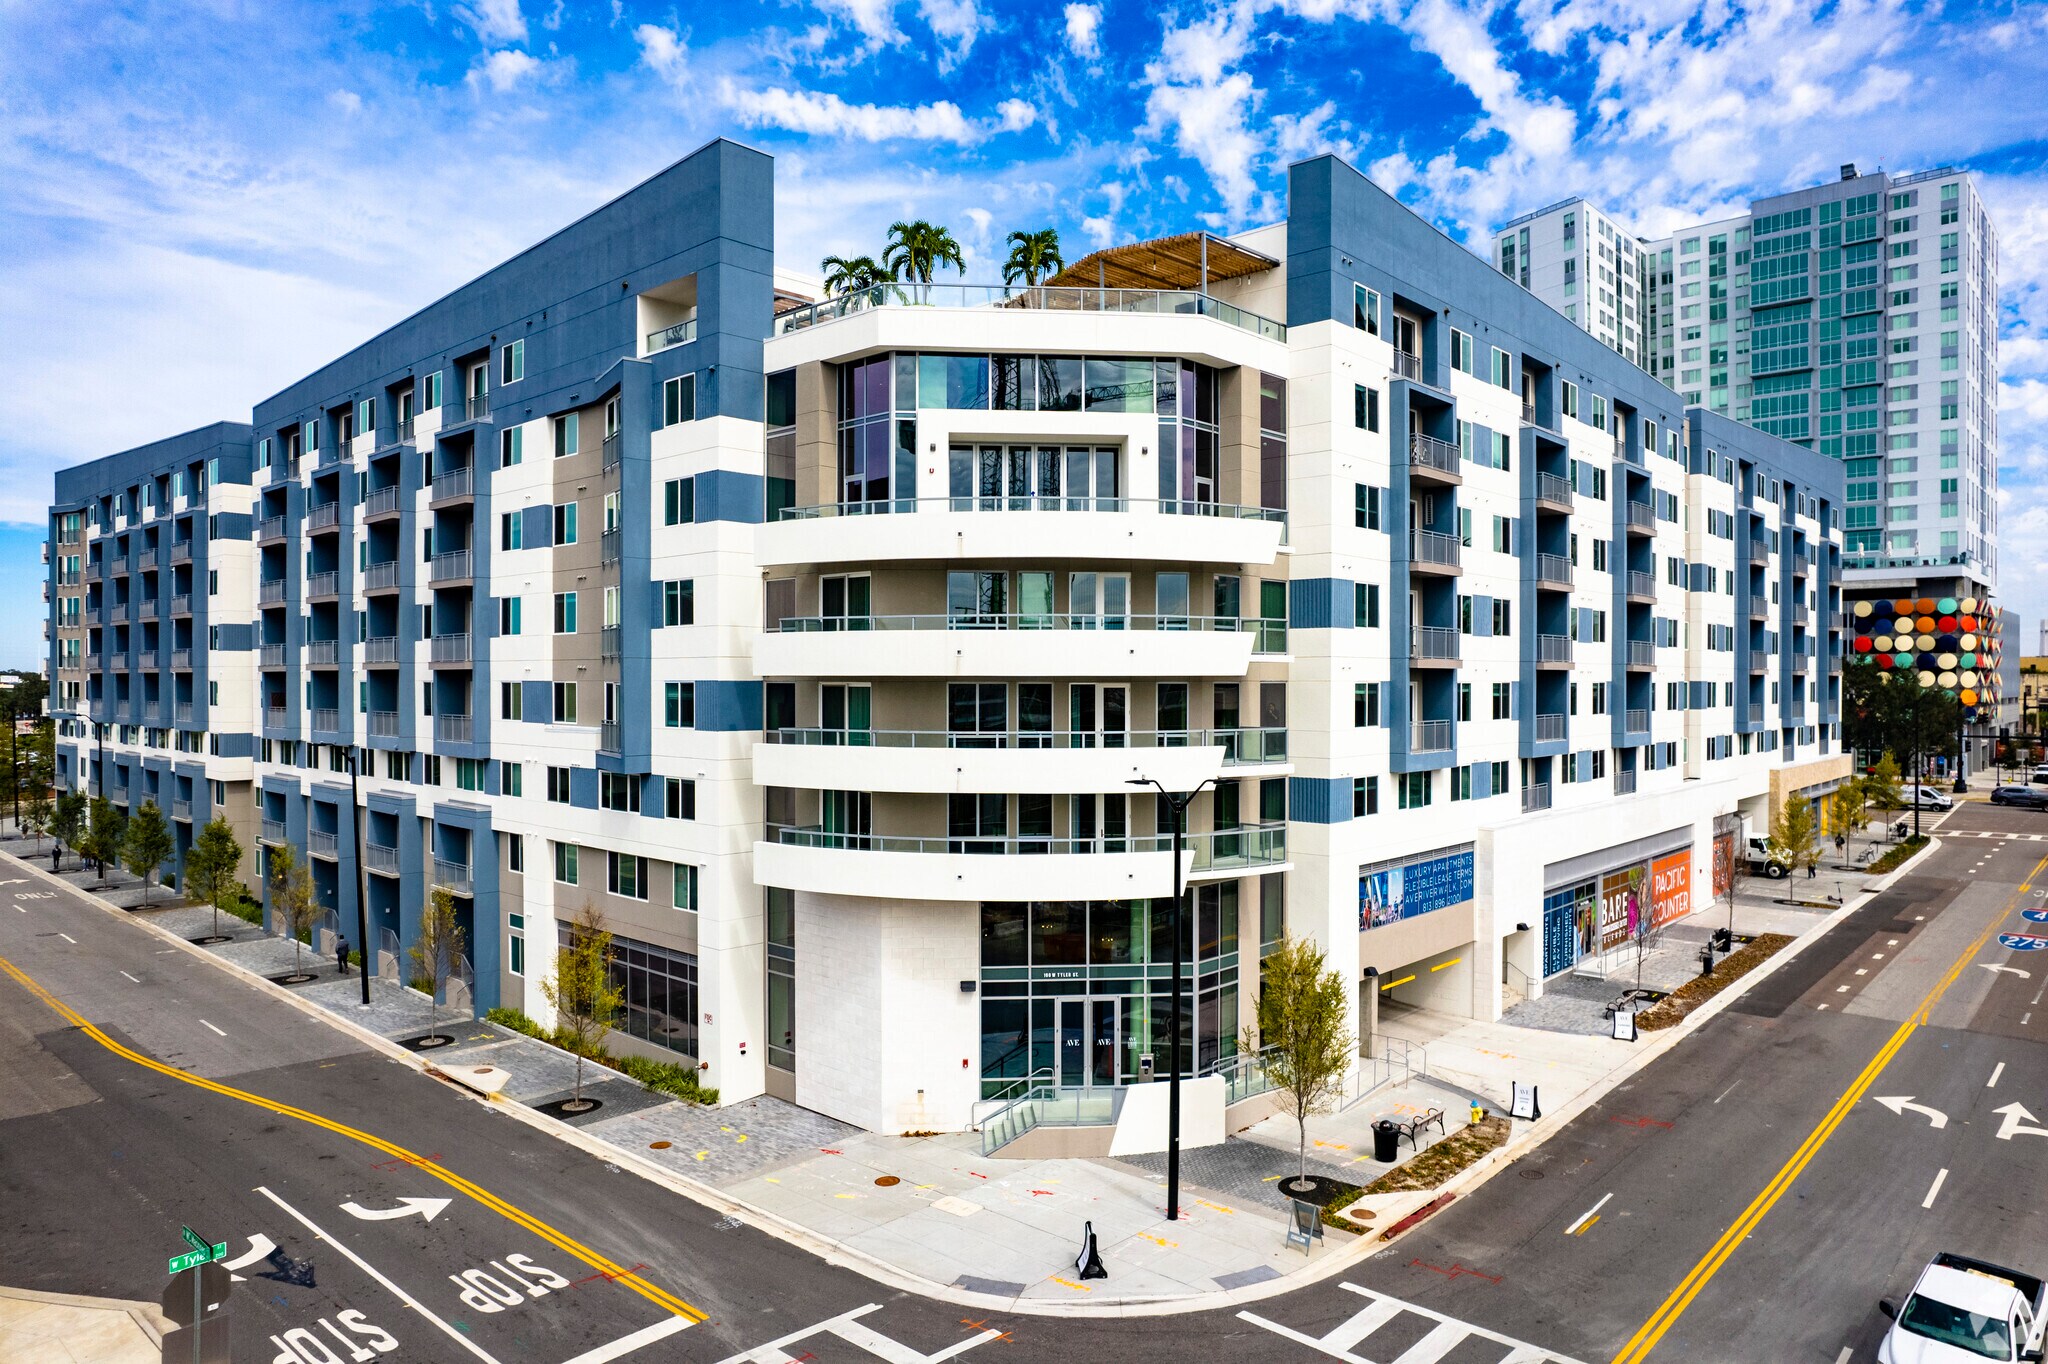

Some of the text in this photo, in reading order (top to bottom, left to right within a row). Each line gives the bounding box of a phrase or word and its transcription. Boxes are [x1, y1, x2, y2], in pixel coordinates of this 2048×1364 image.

[1405, 855, 1472, 881] LUXURY APARTMENTS
[1405, 867, 1472, 892] FLEXIBLE LEASE TERMS
[1656, 866, 1685, 895] PACIFIC
[14, 891, 58, 900] ONLY
[1422, 901, 1432, 913] 813
[1435, 897, 1445, 909] 896
[1602, 891, 1628, 926] BARE
[1651, 891, 1688, 924] COUNTER
[2034, 911, 2048, 921] 4
[2004, 936, 2048, 949] 275
[1065, 1039, 1080, 1047] AVE
[1097, 1038, 1111, 1046] AVE
[171, 1260, 179, 1269] W
[183, 1253, 205, 1267] Tyle
[449, 1253, 571, 1314] STOP
[269, 1308, 399, 1364] STOP
